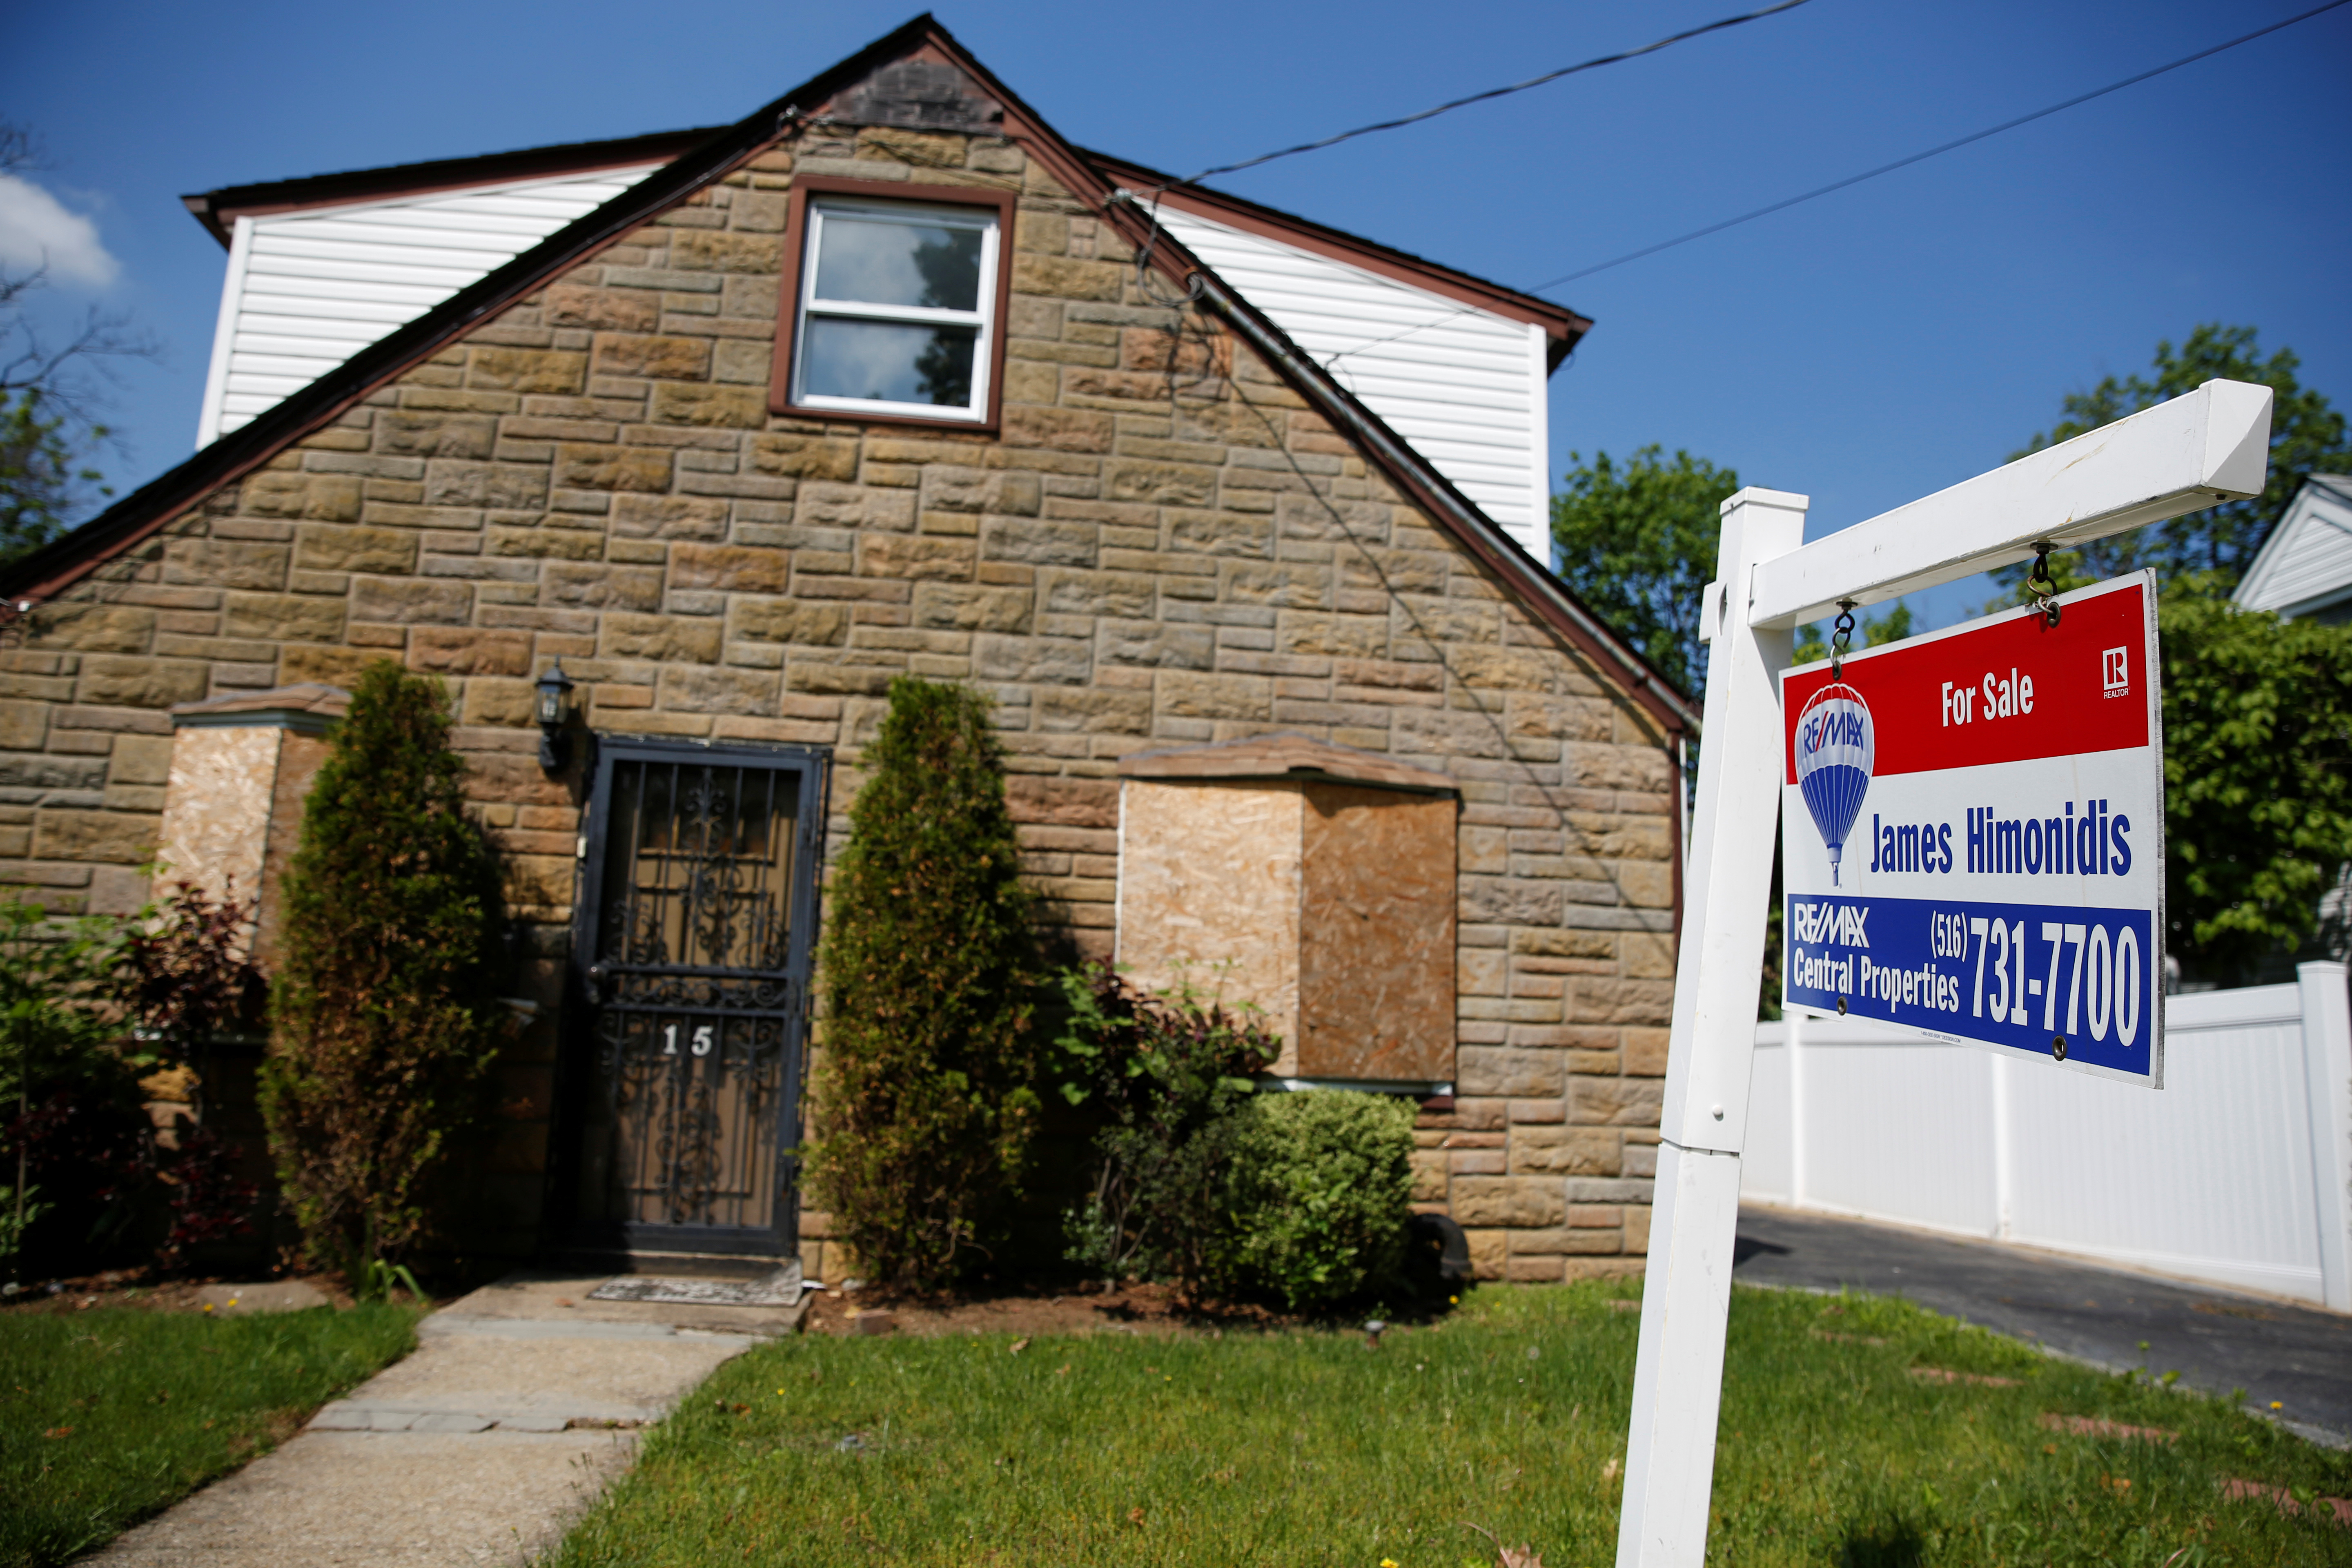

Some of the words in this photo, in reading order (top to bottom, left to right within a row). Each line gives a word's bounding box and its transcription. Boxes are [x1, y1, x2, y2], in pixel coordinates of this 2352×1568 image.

[1942, 681, 1976, 727] For
[1983, 667, 2034, 721] Sale
[2104, 688, 2129, 699] REALTOR
[1804, 711, 1863, 758] RE/MAX
[1871, 813, 1953, 874] James
[1967, 799, 2132, 876] Himonidis
[1794, 902, 1870, 948] RE/MAX
[1793, 947, 1853, 995] Central
[1860, 955, 1959, 1013] Properties
[1931, 910, 1967, 962] (516)
[1971, 917, 2140, 1047] 731-7700
[663, 1023, 714, 1056] 15
